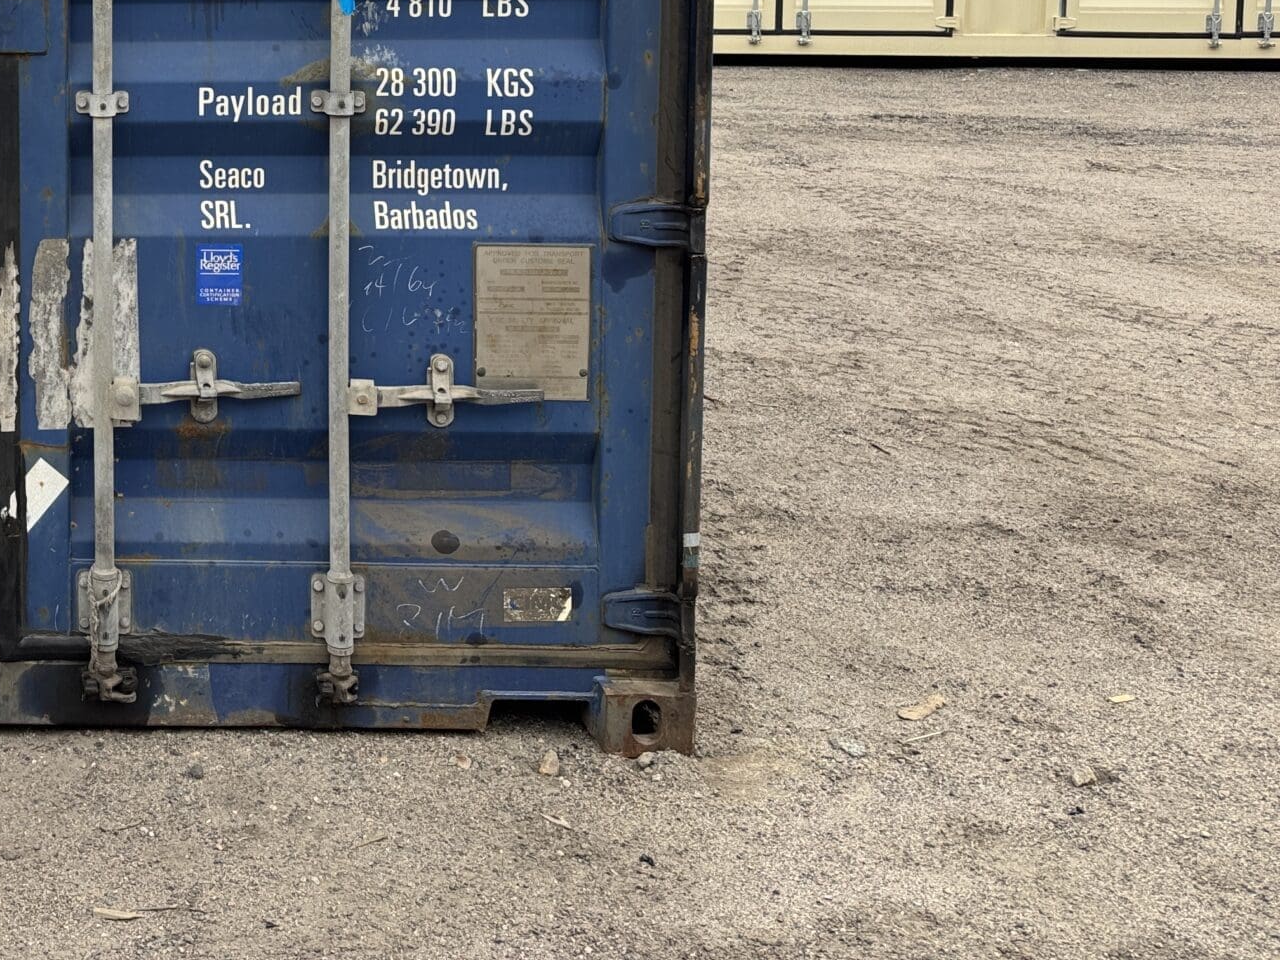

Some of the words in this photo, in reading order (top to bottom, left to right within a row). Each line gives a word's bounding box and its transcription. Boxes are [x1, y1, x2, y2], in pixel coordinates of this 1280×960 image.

[375, 68, 404, 98] 28
[412, 67, 457, 97] 300
[486, 67, 535, 98] KGS
[199, 86, 302, 123] Payload
[374, 108, 403, 136] 62
[411, 108, 456, 136] 390
[485, 108, 534, 137] LBS
[199, 160, 265, 190] Seaco
[372, 160, 509, 196] Bridgetown,
[200, 201, 252, 230] SRL.
[374, 201, 479, 231] Barbados
